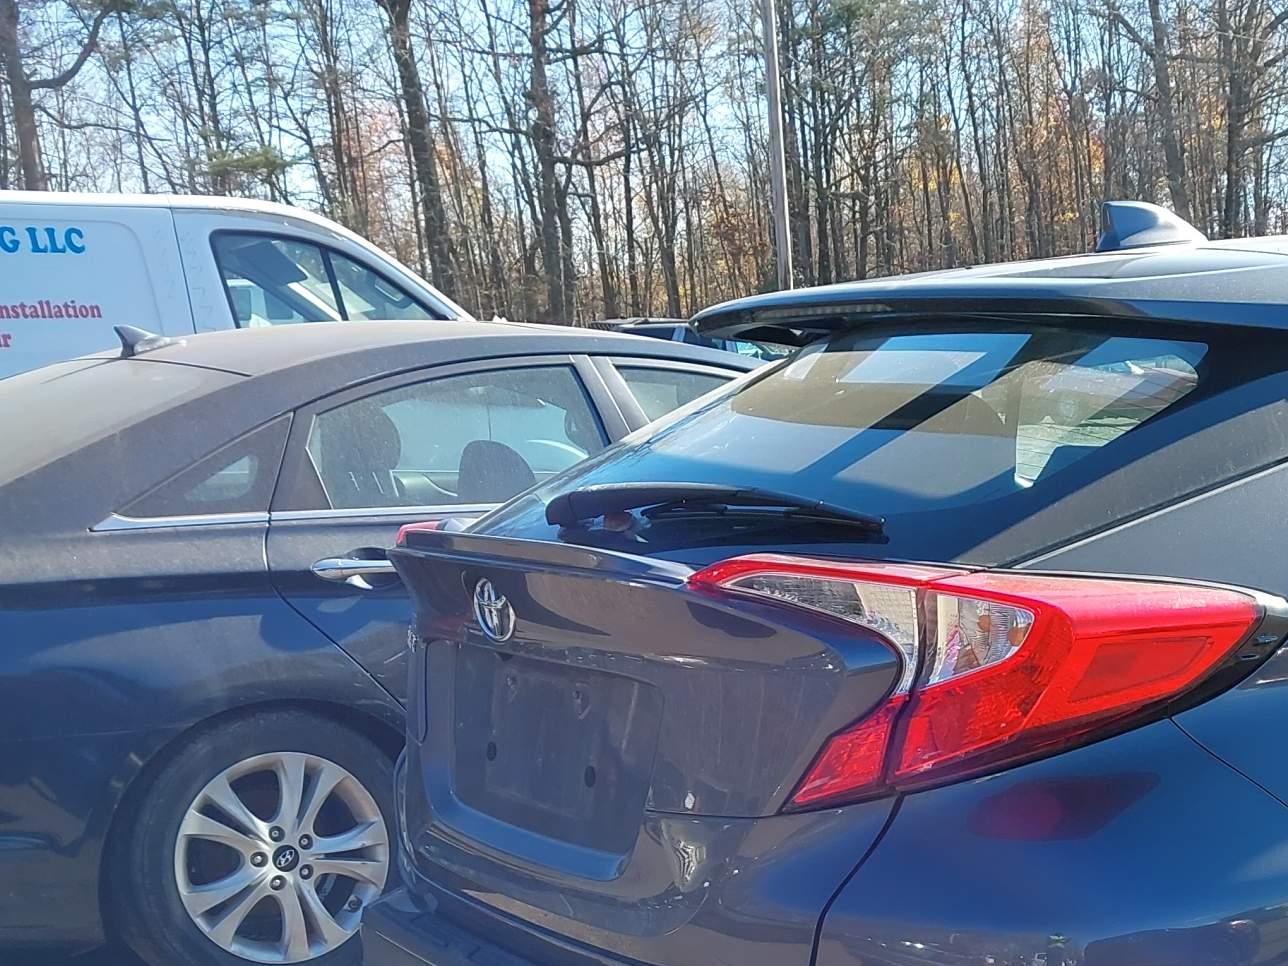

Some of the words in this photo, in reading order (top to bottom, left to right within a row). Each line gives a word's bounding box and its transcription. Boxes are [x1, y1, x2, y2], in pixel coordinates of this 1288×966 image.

[0, 226, 20, 253] G
[25, 226, 86, 254] LLC
[0, 299, 102, 318] nstallation
